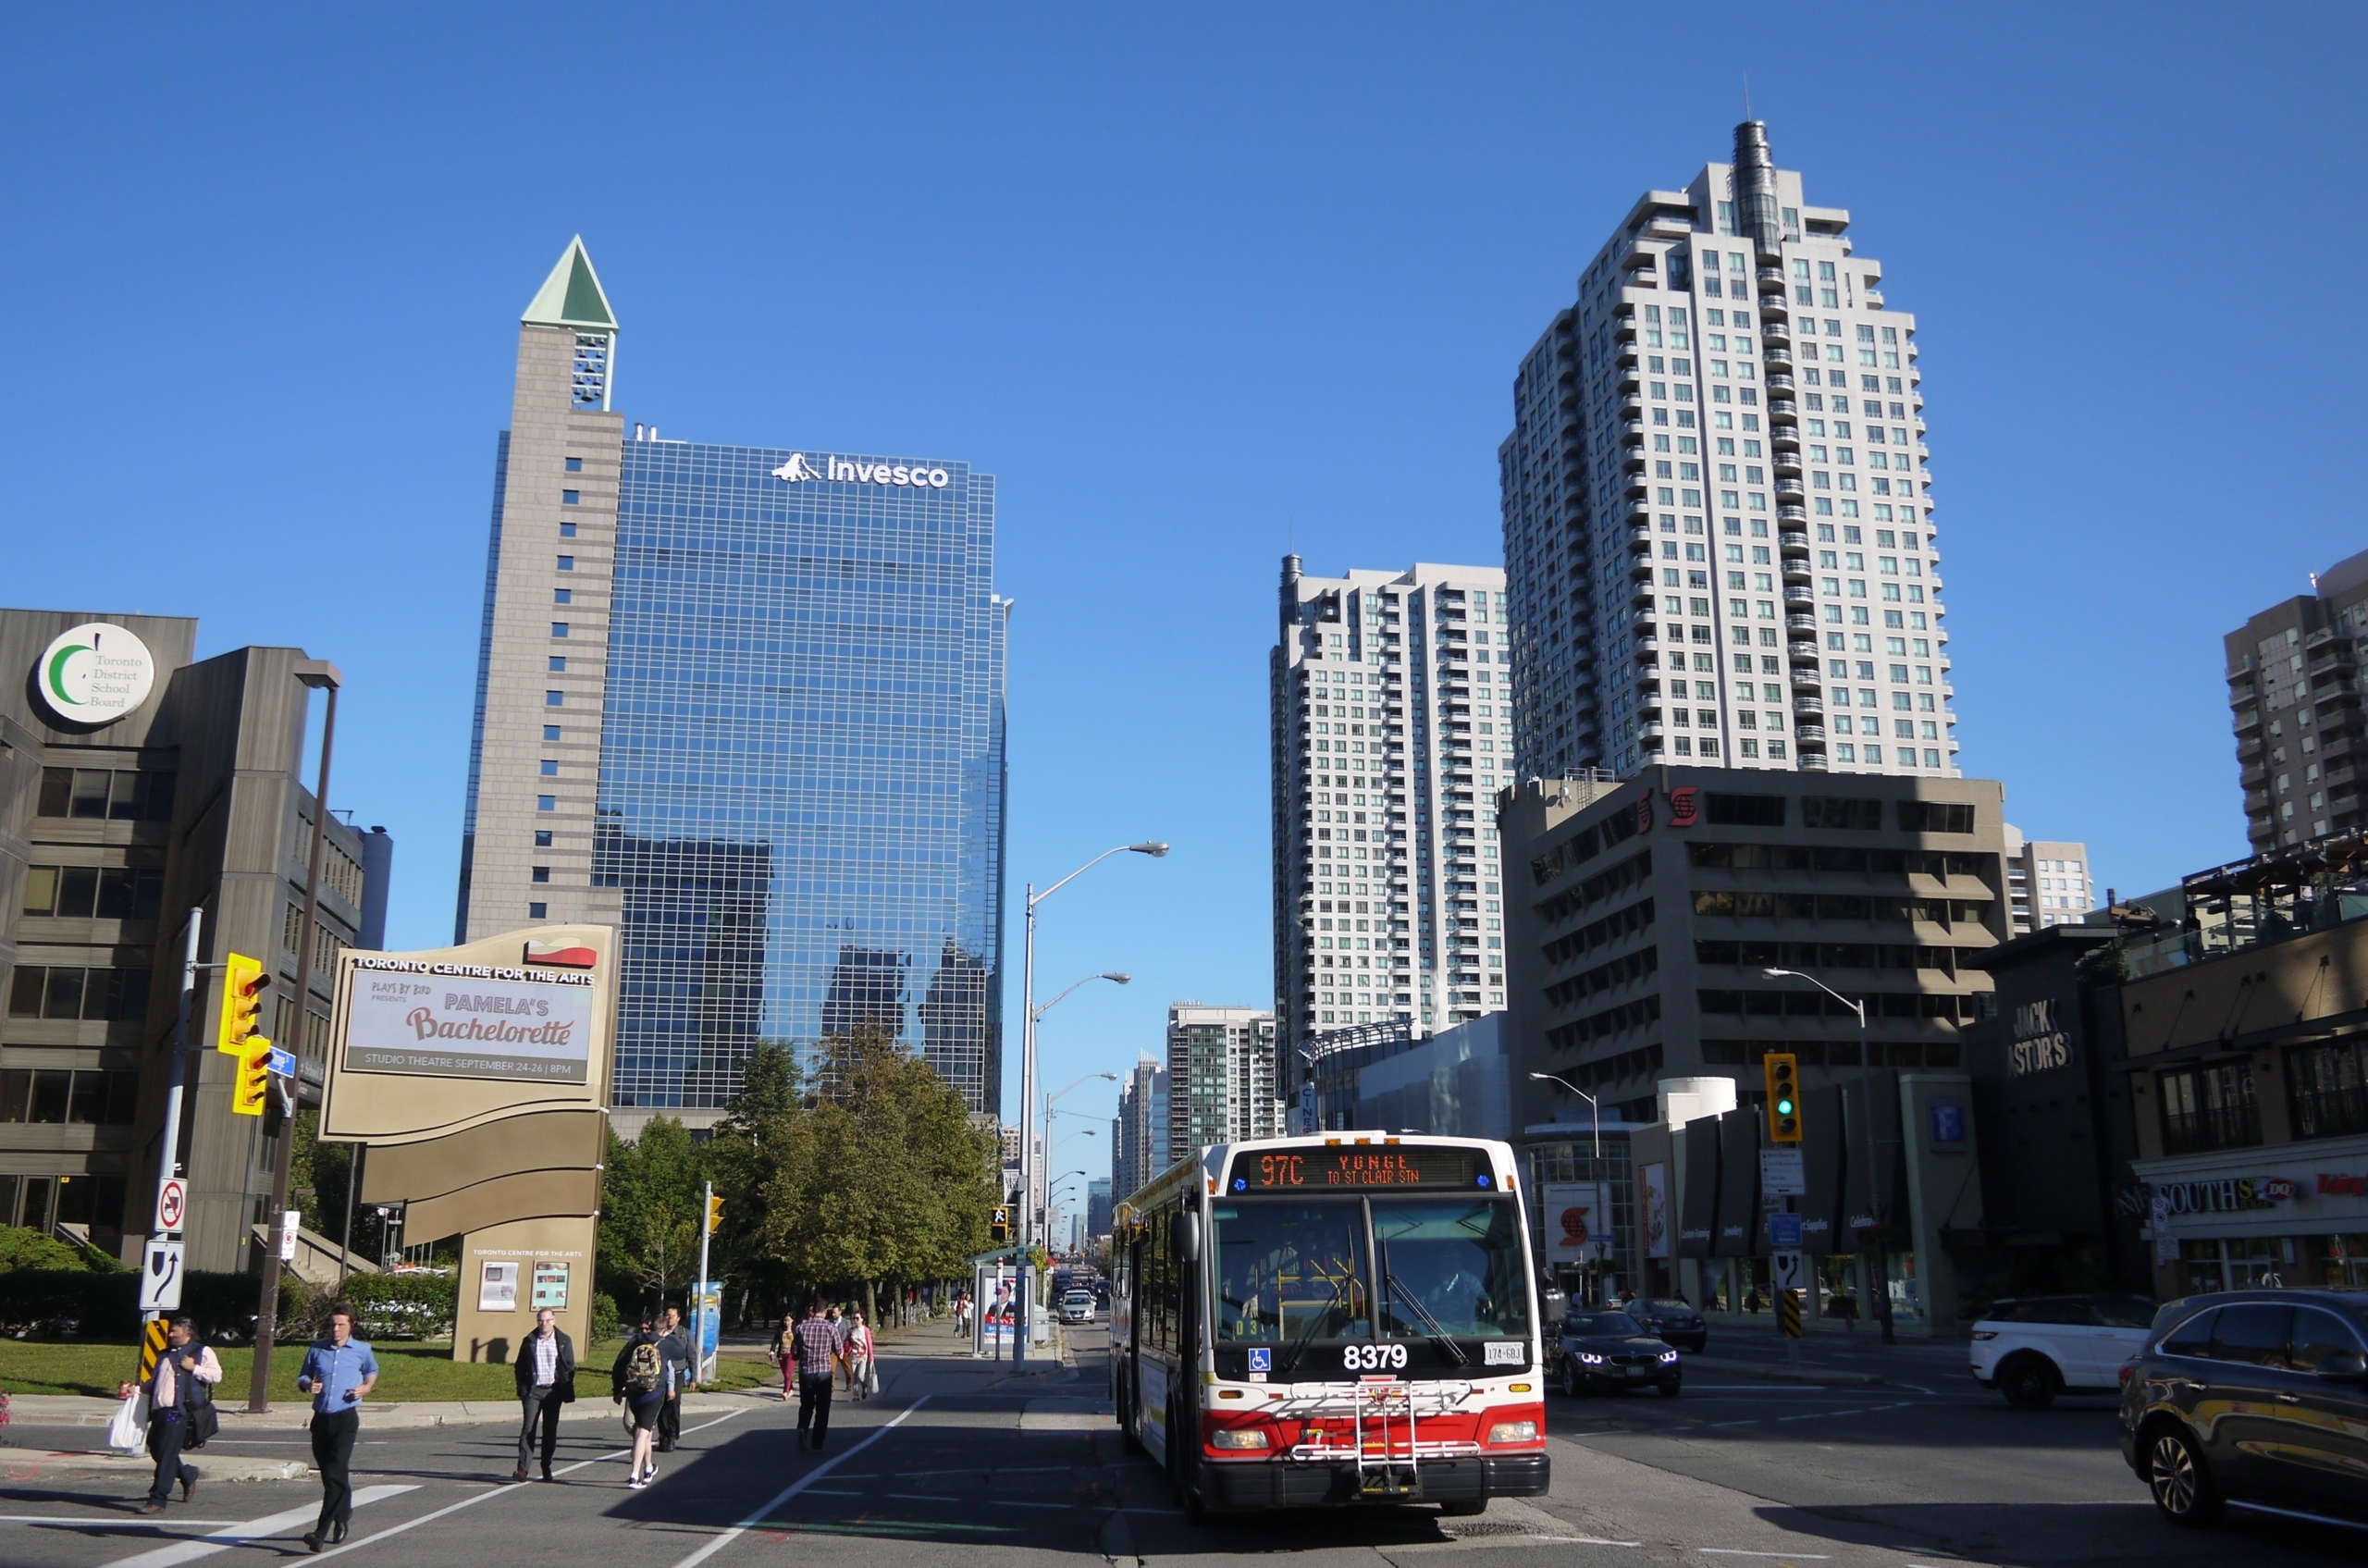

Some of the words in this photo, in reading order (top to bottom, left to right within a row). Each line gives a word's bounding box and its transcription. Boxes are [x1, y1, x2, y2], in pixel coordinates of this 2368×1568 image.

[827, 455, 949, 488] Invesco
[96, 655, 142, 667] Toronto
[93, 669, 137, 680] District
[91, 683, 130, 694] School
[90, 696, 125, 708] Board
[355, 956, 429, 972] TORONTO
[433, 962, 491, 977] CENTRE
[494, 967, 524, 980] FOR
[528, 969, 555, 982] THE
[558, 972, 596, 984] ARTS
[371, 994, 407, 1003] PRESENTS
[372, 982, 397, 994] PLAYS
[399, 982, 411, 995] BY
[413, 983, 432, 995] BIRD
[444, 993, 549, 1017] PAMELA'S
[405, 1006, 574, 1046] Bachelorette
[2013, 999, 2052, 1039] JACK
[364, 1053, 405, 1065] STUDIO
[407, 1056, 453, 1068] THEATRE
[455, 1058, 514, 1071] SEPTEMBER
[516, 1062, 543, 1073] 24-26
[549, 1064, 572, 1074] 8PM
[1261, 1155, 1304, 1186] 97C
[1338, 1155, 1407, 1170] YONGE
[1327, 1170, 1340, 1184] TO
[1344, 1170, 1357, 1184] ST
[1362, 1169, 1394, 1184] CLAIR
[1399, 1169, 1420, 1184] STN
[2316, 1172, 2363, 1198] Dairy
[2157, 1179, 2239, 1215] SOUTH
[1343, 1343, 1408, 1370] 8379
